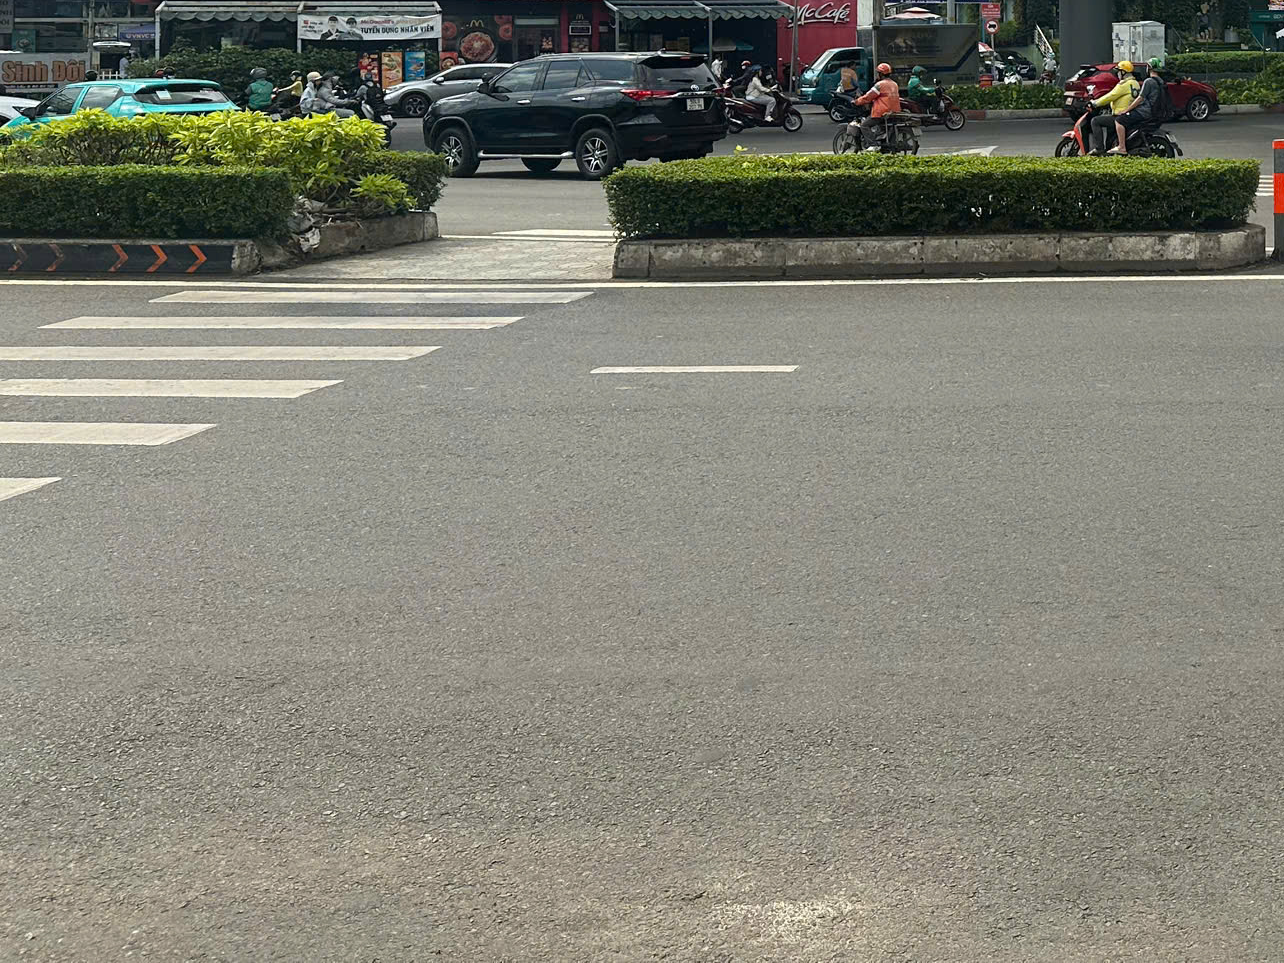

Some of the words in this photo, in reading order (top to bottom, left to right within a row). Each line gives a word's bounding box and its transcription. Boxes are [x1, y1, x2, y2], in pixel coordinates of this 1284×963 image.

[796, 1, 851, 26] McCafé
[360, 25, 381, 34] TUYỂN
[381, 26, 399, 34] DỤNG
[400, 25, 419, 33] NHÂN
[420, 24, 435, 33] VIÊN
[2, 60, 49, 83] Sinh
[52, 59, 86, 83] Đôi
